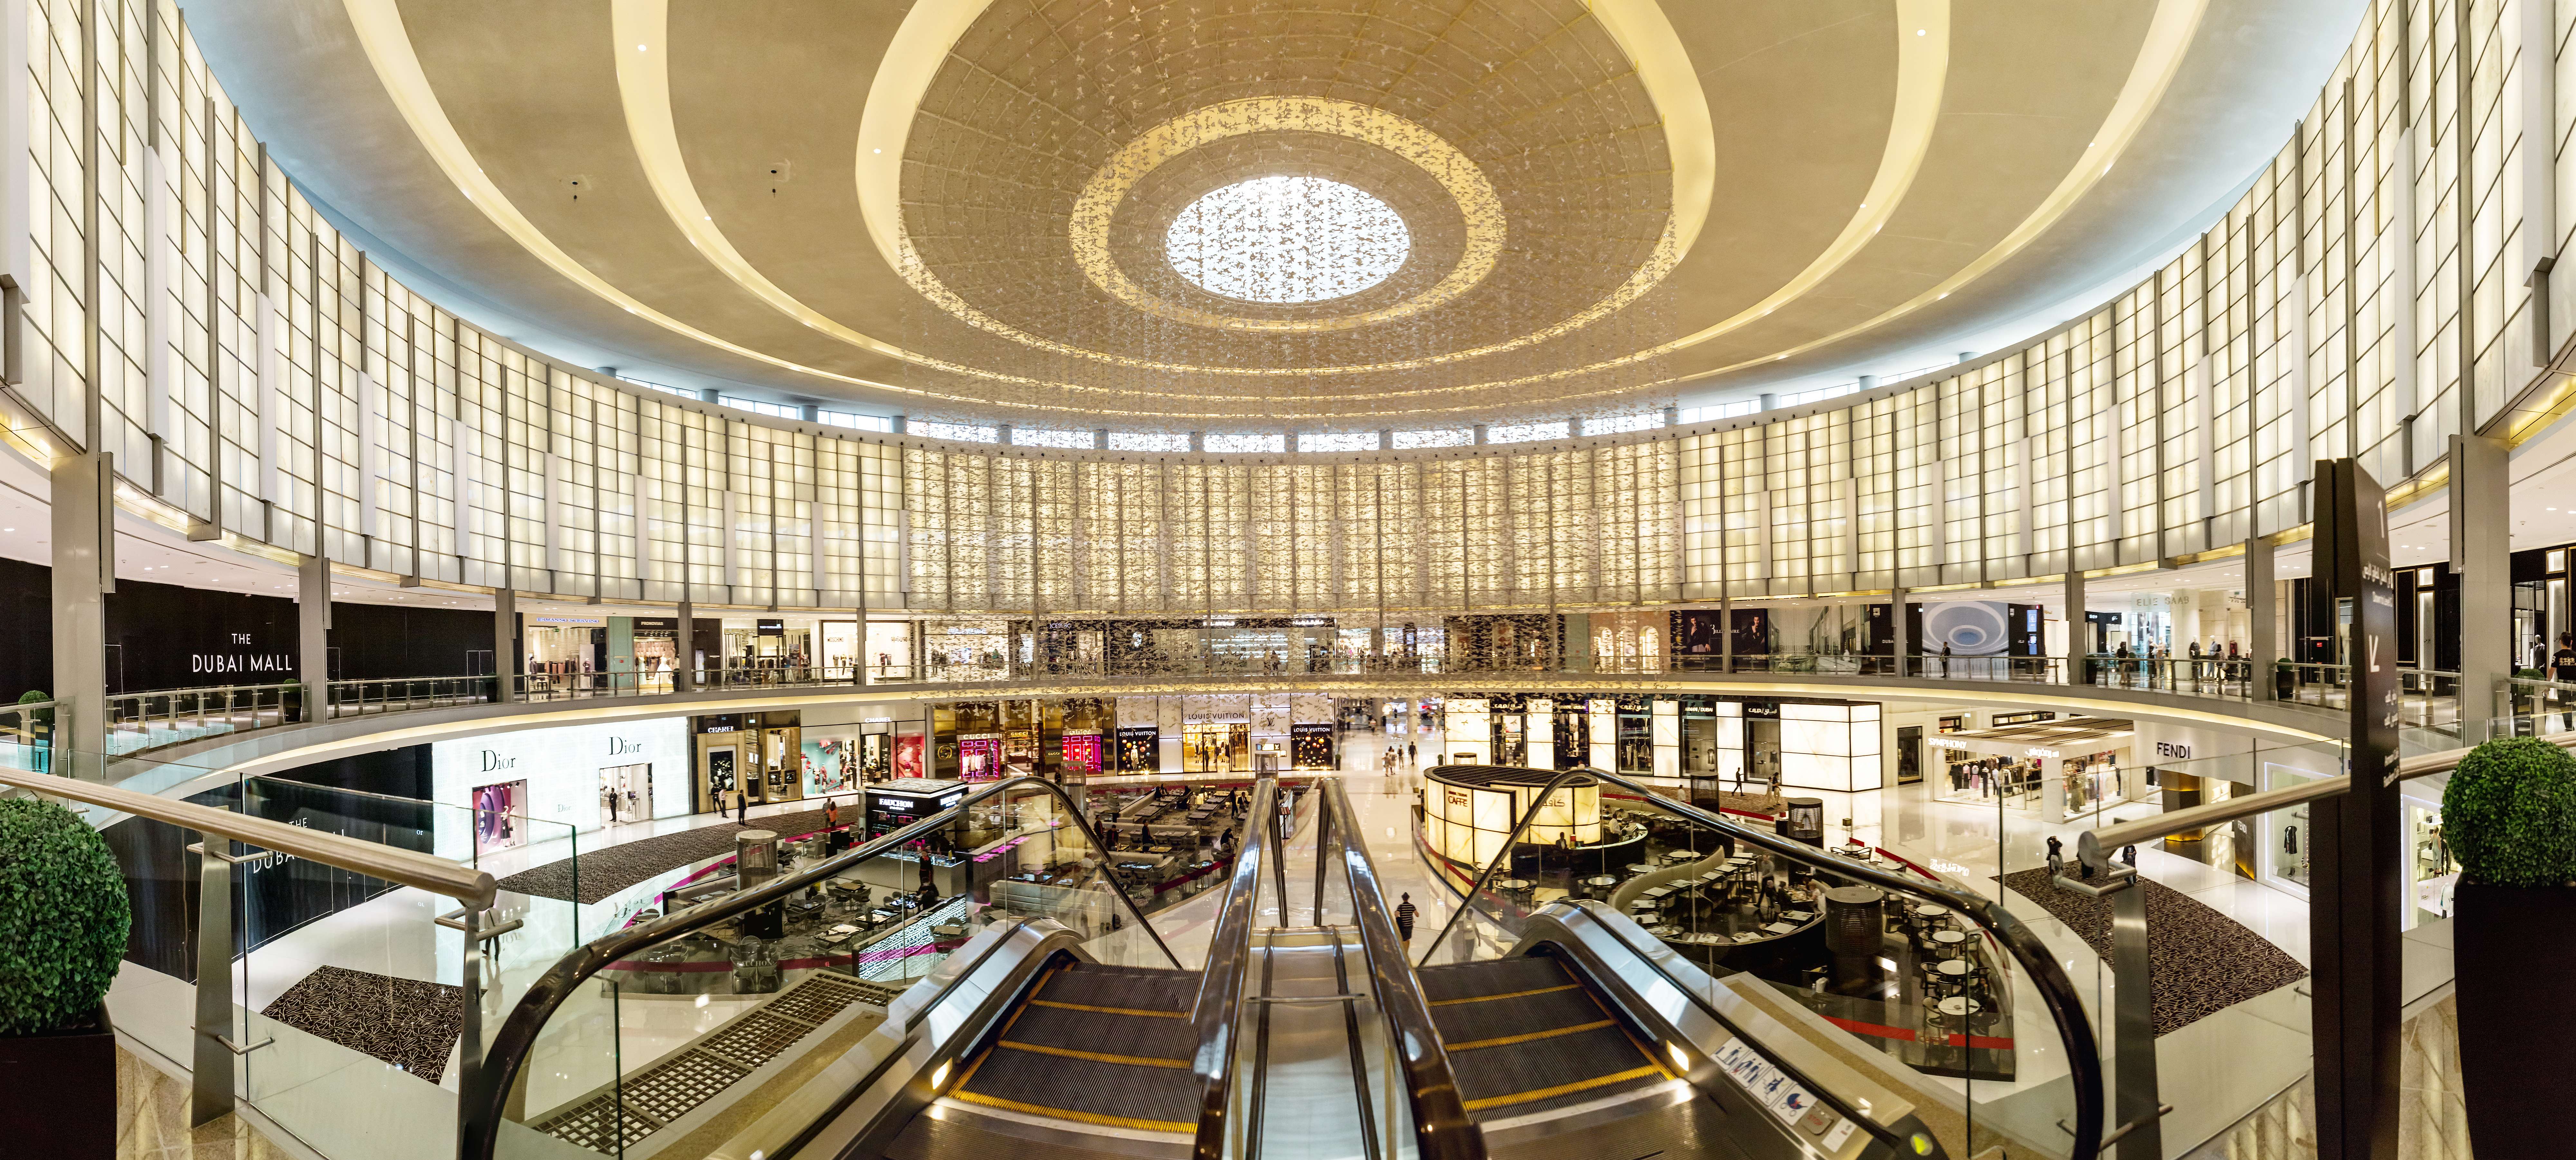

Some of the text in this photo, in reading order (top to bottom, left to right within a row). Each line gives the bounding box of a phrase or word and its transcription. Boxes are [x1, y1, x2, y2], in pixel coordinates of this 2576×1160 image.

[2137, 596, 2189, 606] ELIE SAAB
[232, 633, 251, 644] THE
[193, 654, 292, 672] DUBAI MALL
[608, 737, 641, 755] Dior
[1928, 737, 1967, 749] SYMPHONY
[2157, 742, 2190, 759] FENDI
[481, 750, 516, 772] Dior
[558, 804, 571, 812] Dior
[879, 798, 914, 808] FAUCHON
[1448, 796, 1467, 807] CAFFE
[2238, 820, 2247, 834] FENDI
[253, 851, 299, 874] DUBA
